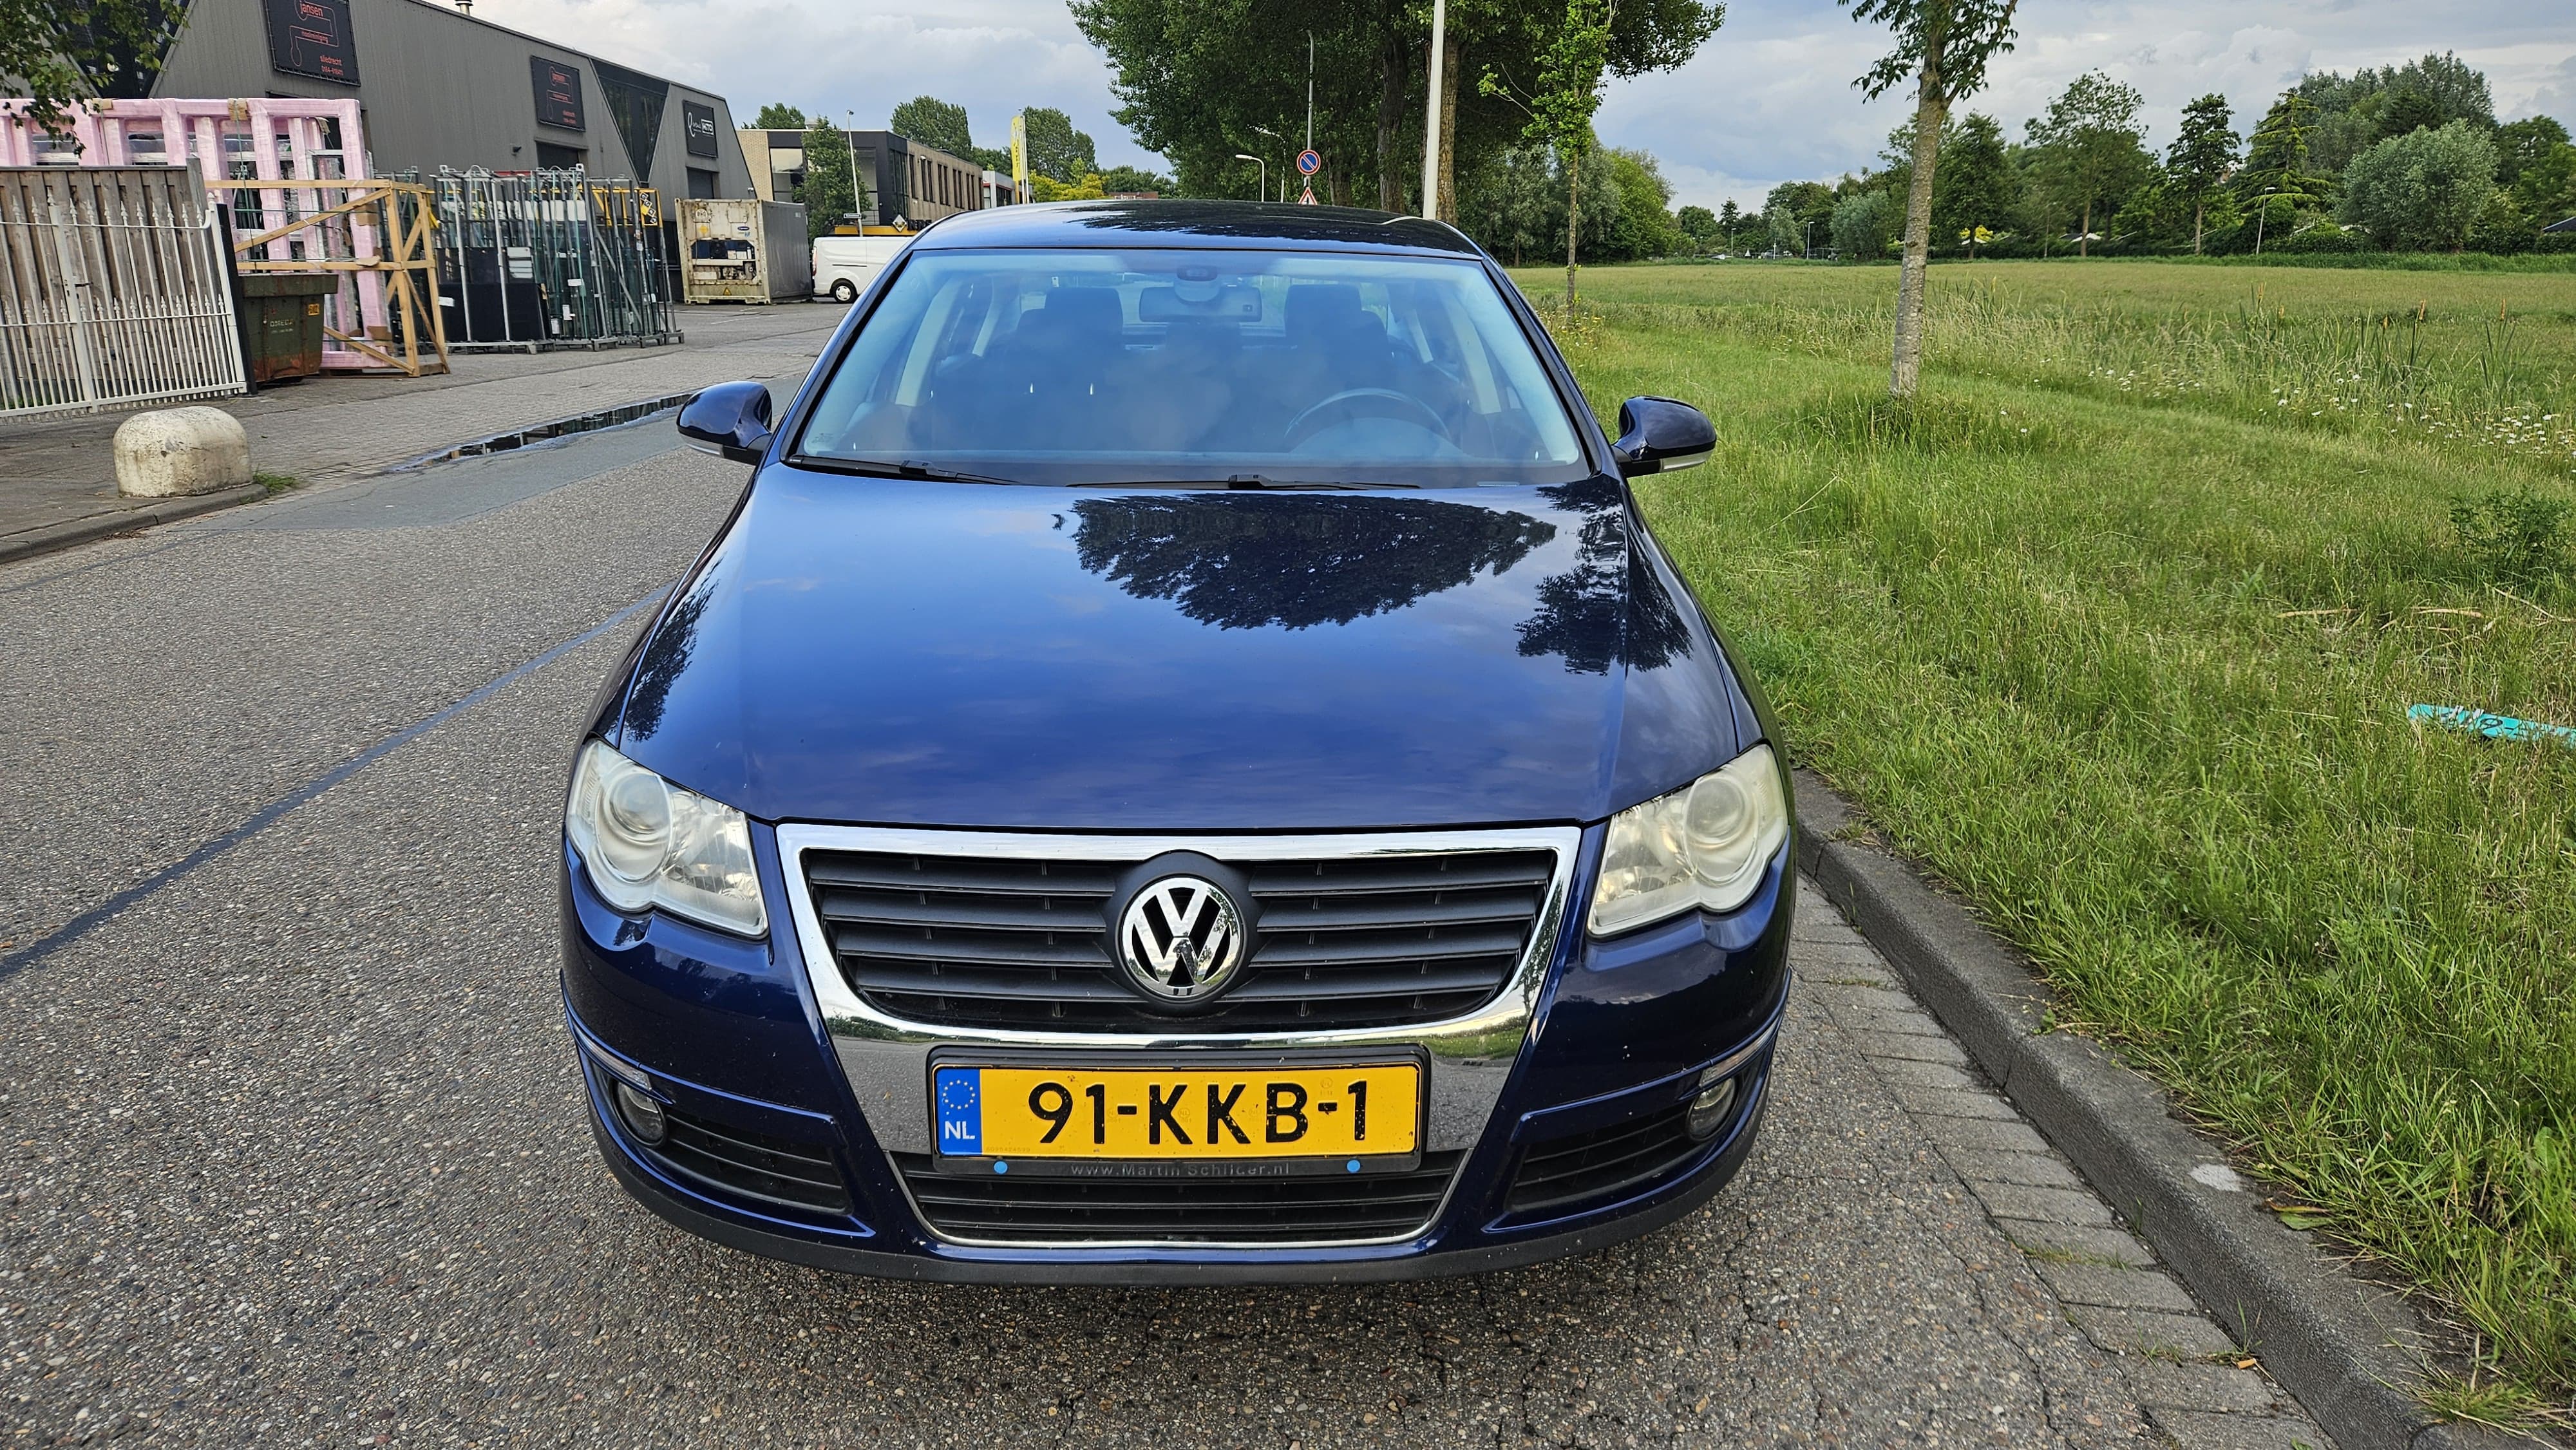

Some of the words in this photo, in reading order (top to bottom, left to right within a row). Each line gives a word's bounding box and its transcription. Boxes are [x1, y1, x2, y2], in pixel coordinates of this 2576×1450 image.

[299, 1, 323, 17] jansen
[1028, 1081, 1367, 1145] 91-KKB-1
[945, 1121, 976, 1139] NL
